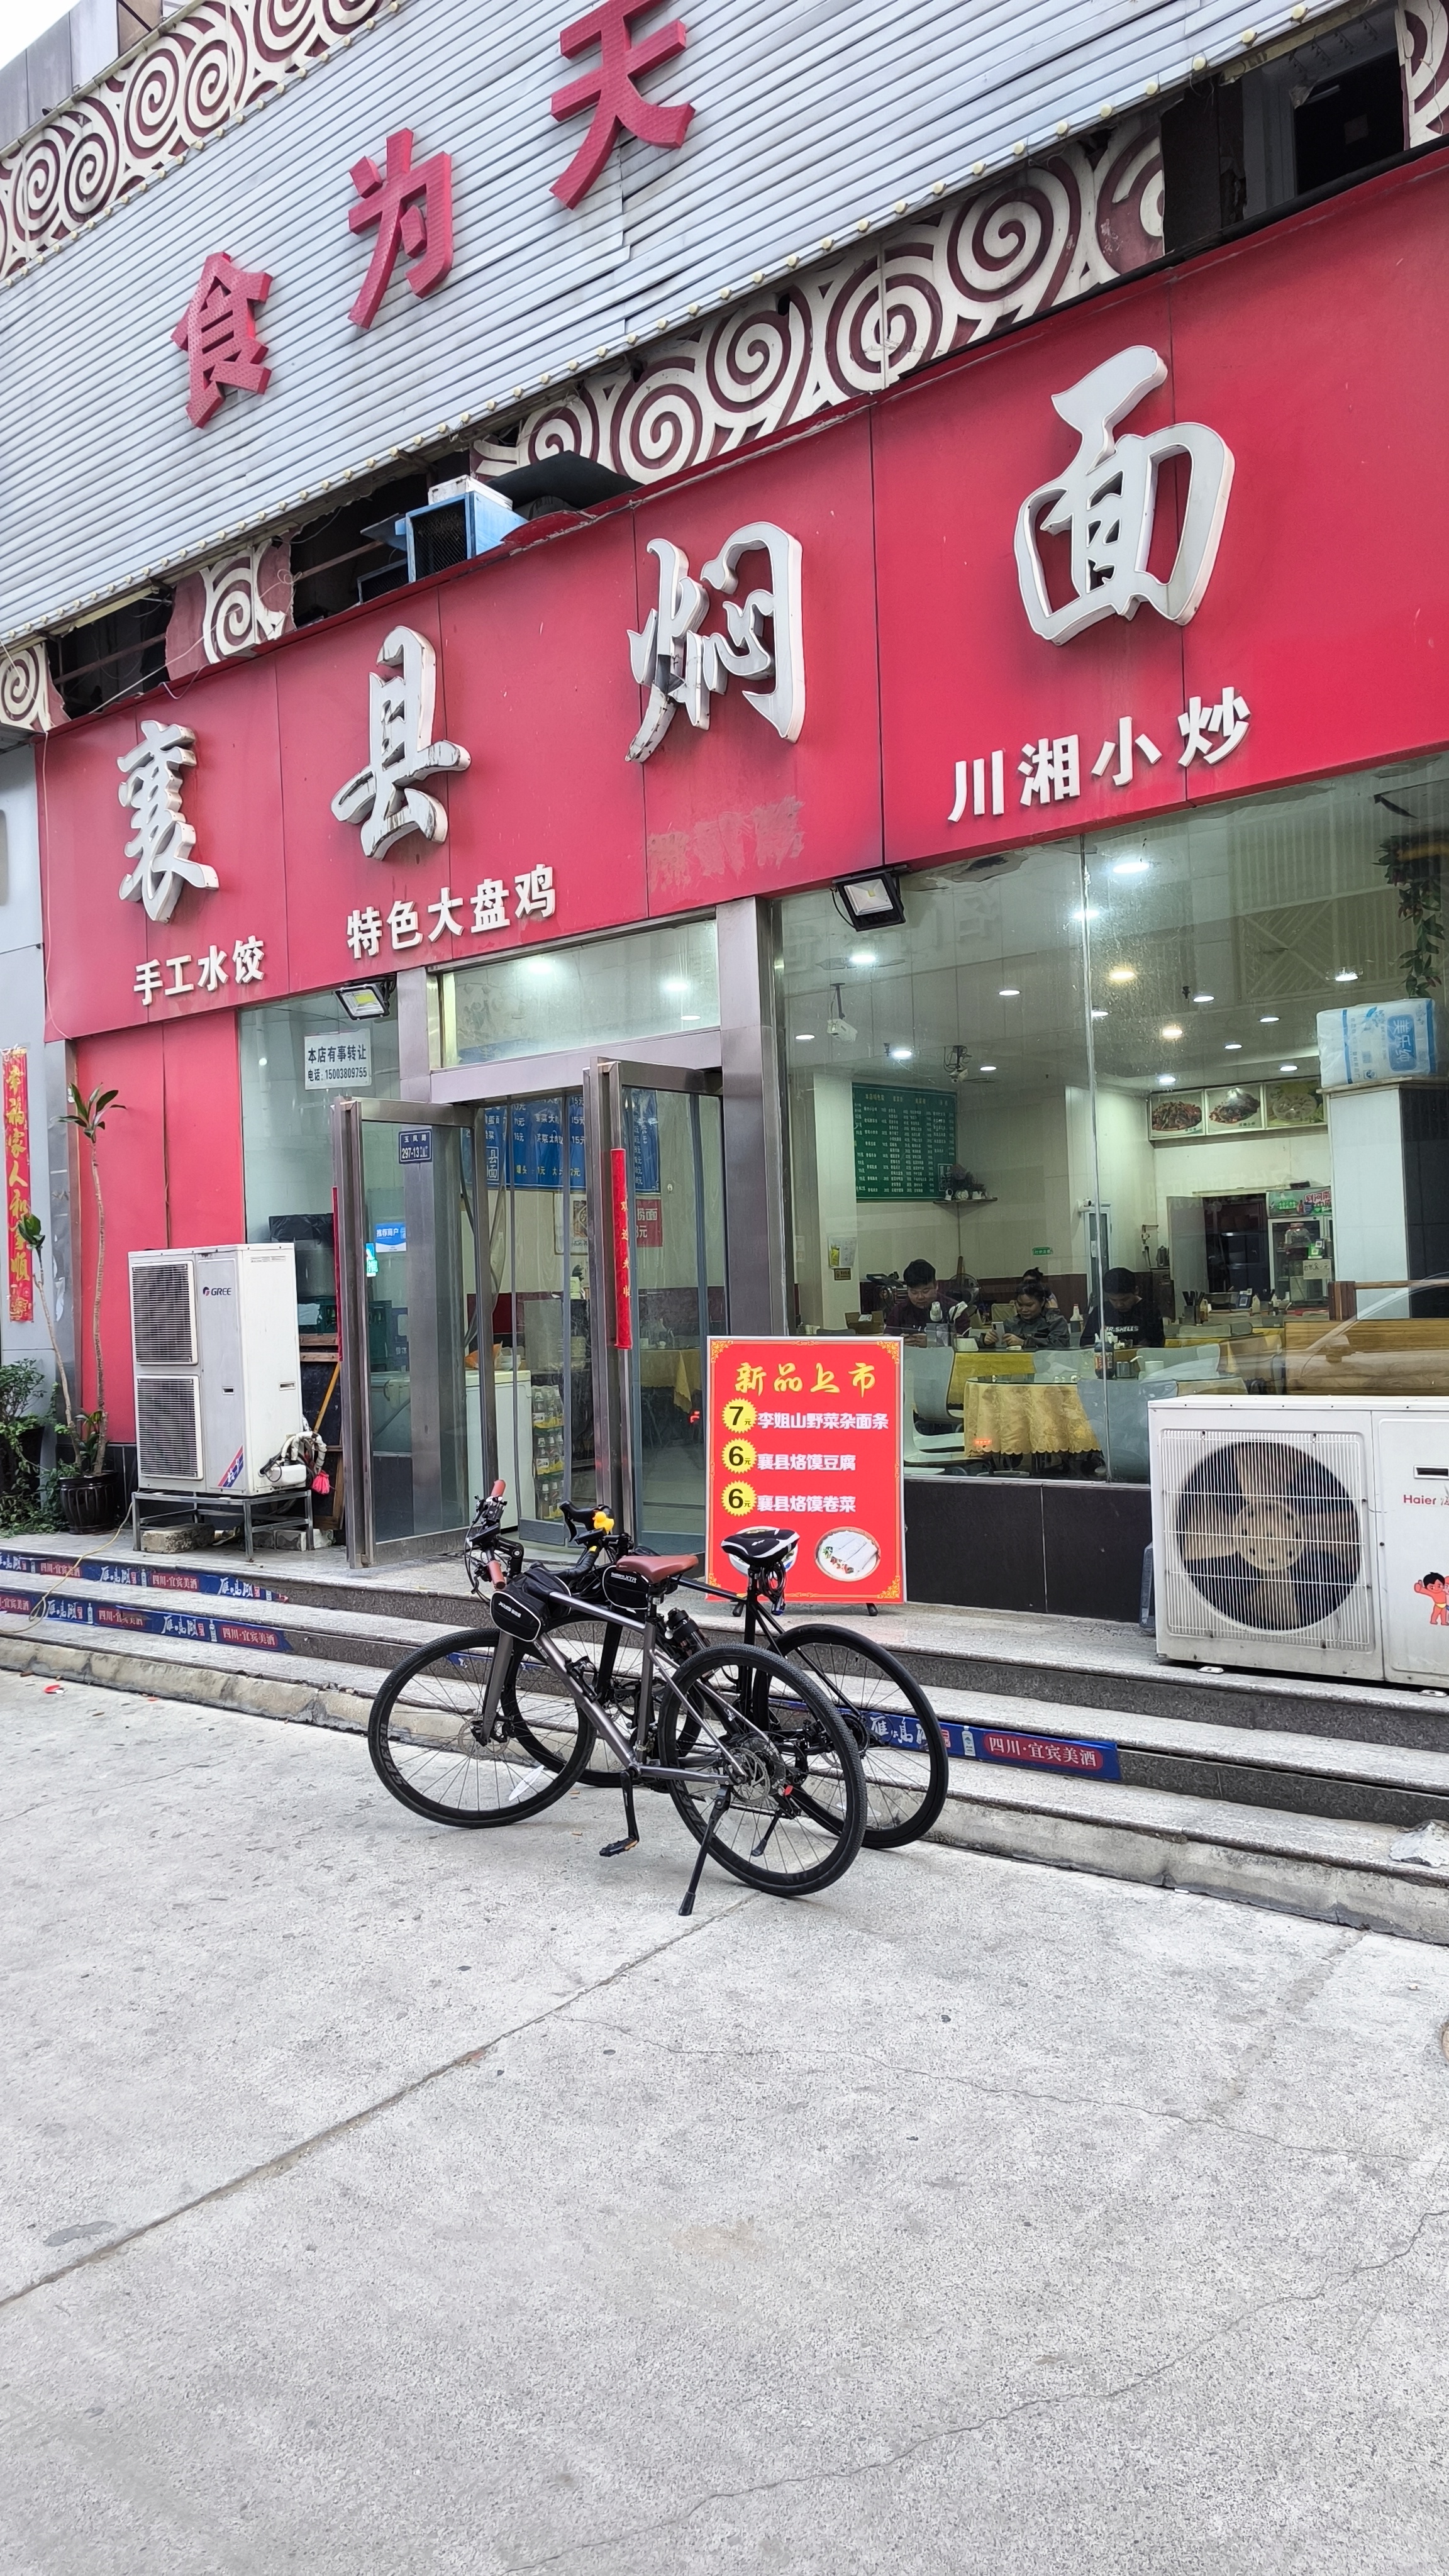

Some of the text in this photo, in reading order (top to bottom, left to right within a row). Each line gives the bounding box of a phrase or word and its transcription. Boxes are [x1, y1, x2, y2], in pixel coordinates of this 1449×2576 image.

[170, 0, 696, 428] 食为天
[118, 345, 1236, 923] 襄县焖面
[948, 686, 1251, 822] 川湘小炒
[347, 863, 555, 960] 特色大盘鸡
[133, 935, 265, 1006] 手工水饺
[308, 1044, 367, 1063] 本店有事转让
[308, 1067, 367, 1082] 电话:15003809755
[211, 1287, 232, 1296] GREE
[735, 1362, 876, 1398] 新品上市
[757, 1412, 889, 1430] 李姐山野菜杂面条
[757, 1453, 857, 1472] 襄县烙馍豆腐
[757, 1495, 857, 1513] 襄县烙馍卷菜
[1403, 1494, 1436, 1505] Haier
[989, 1737, 1096, 1767] 四川·宜宾美酒
